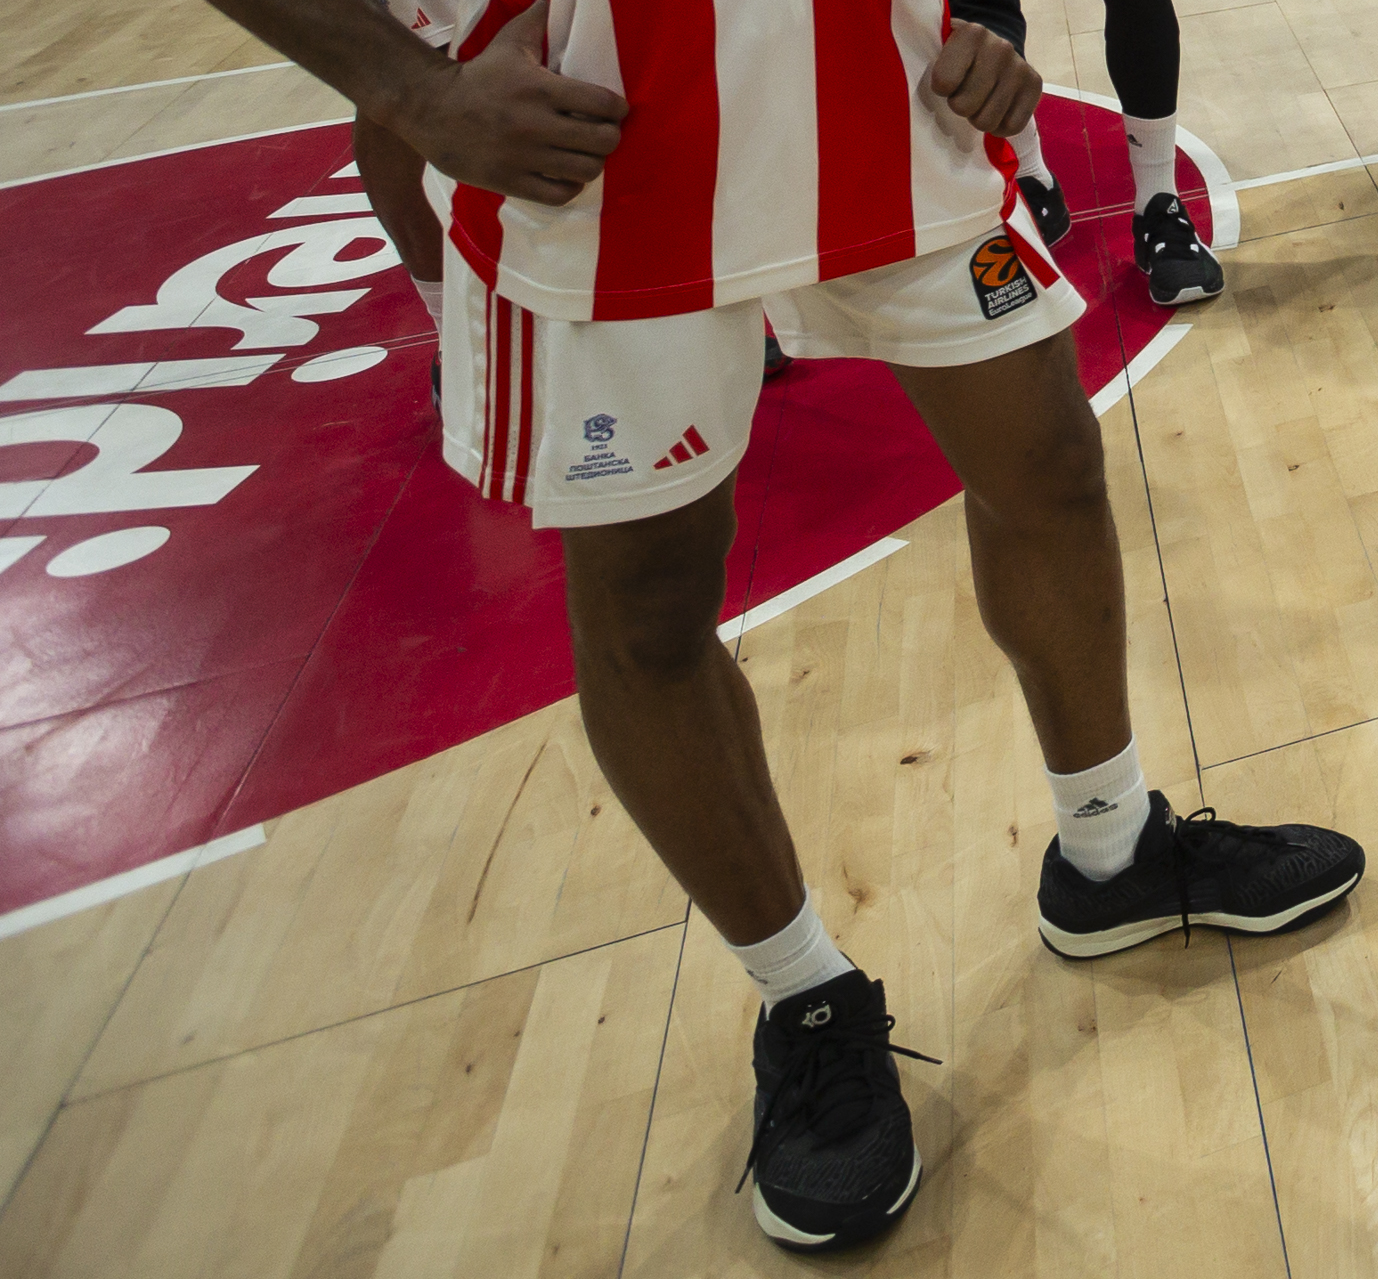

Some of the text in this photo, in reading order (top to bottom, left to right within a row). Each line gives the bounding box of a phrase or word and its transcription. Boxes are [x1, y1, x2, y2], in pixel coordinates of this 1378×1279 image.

[984, 276, 1026, 301] TURKISH
[987, 283, 1029, 309] AIRLINES
[988, 292, 1032, 316] EuroLeague
[568, 458, 629, 472] ПОШТАНСКА
[583, 452, 615, 462] БАНКА
[565, 466, 633, 481] ШТЕДИОНИЦА
[1072, 803, 1118, 819] adidas
